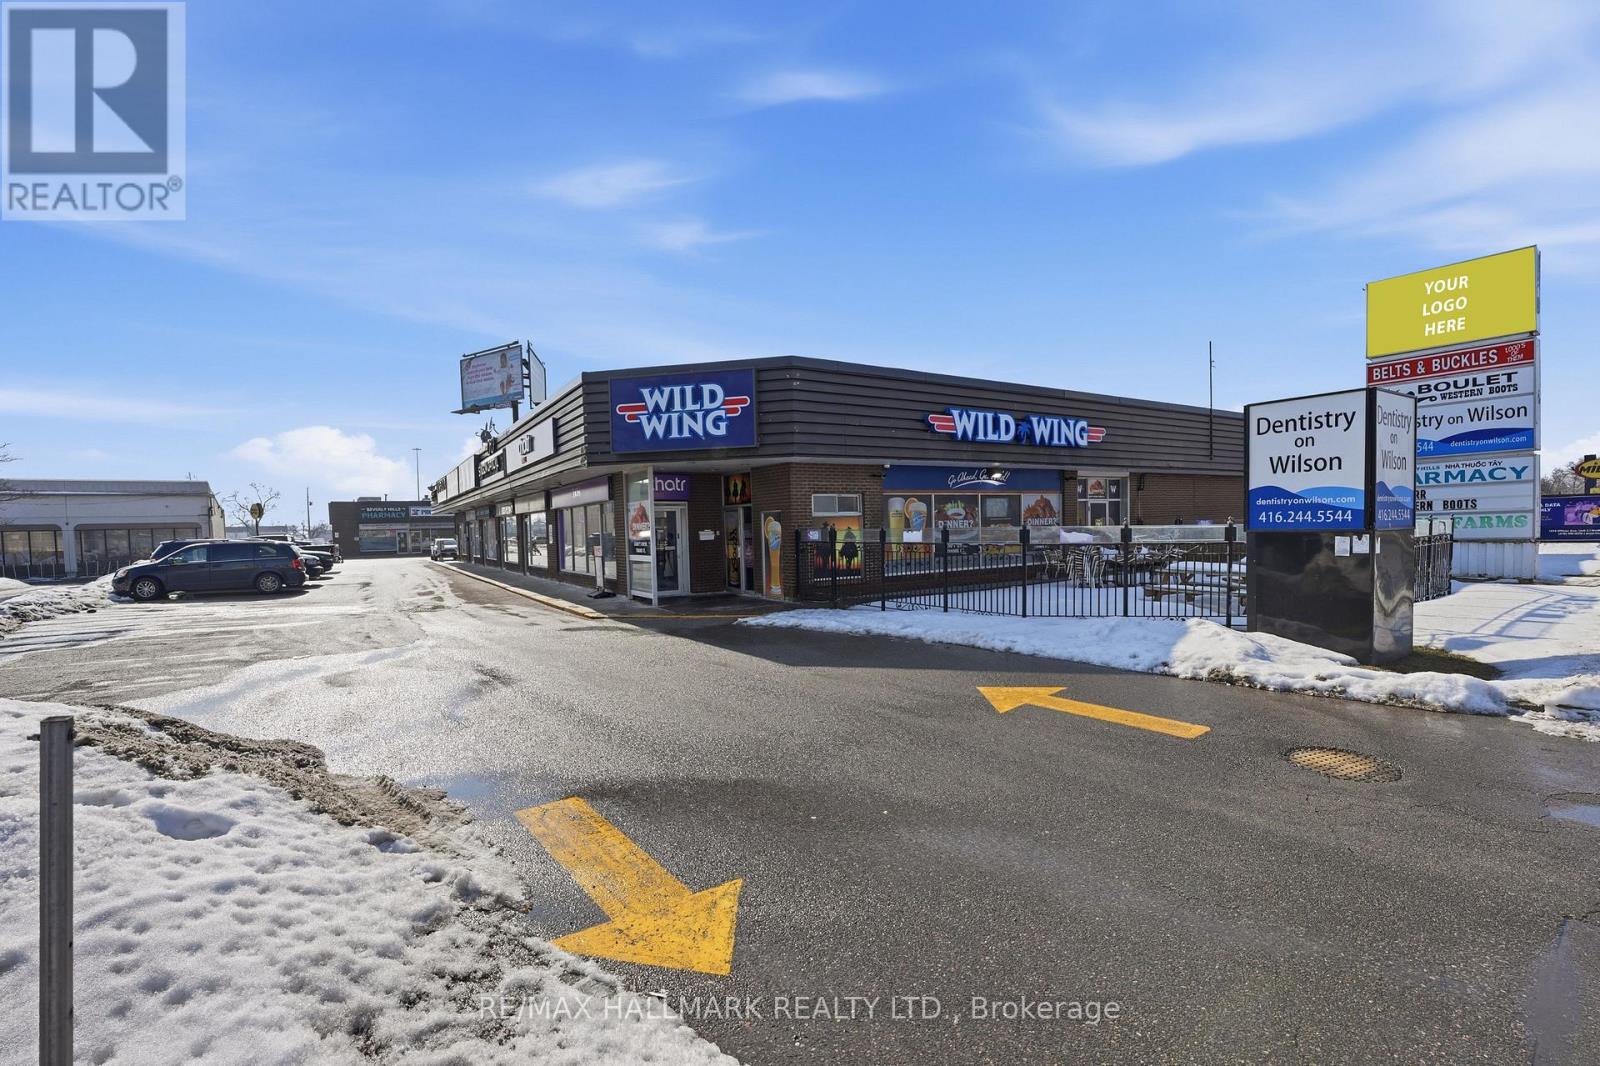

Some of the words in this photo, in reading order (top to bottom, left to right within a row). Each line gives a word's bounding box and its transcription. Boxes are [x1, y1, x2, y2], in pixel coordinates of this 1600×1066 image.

[1424, 275, 1469, 295] YOUR
[1422, 296, 1467, 316] LOGO
[1424, 317, 1466, 336] HERE
[1373, 364, 1411, 380] BELTS
[1416, 362, 1426, 374] &
[1432, 349, 1498, 371] BUCKLES
[1417, 371, 1518, 394] BOULET
[1440, 387, 1483, 401] WESTERN
[1488, 383, 1519, 395] BOOTS
[640, 383, 725, 413] WILD
[1256, 411, 1356, 436] Dentistry
[1378, 405, 1412, 434] Dentistry
[1447, 415, 1463, 424] on
[1467, 404, 1527, 422] Wilson
[639, 409, 727, 440] WING
[950, 409, 1016, 442] WILD
[1029, 416, 1088, 447] WING
[1294, 436, 1315, 448] on
[1390, 432, 1398, 445] on
[1450, 436, 1527, 447] dentistryonwilson.com
[1269, 454, 1343, 474] Wilson
[1381, 449, 1407, 470] Wilson
[1256, 496, 1356, 506] dentistryonwilson.com
[1443, 499, 1477, 510] BOOTS
[361, 511, 406, 519] PHARMACY
[938, 519, 974, 528] DNNER?
[1258, 510, 1353, 523] 416.244.5544
[1453, 514, 1529, 529] FARMS
